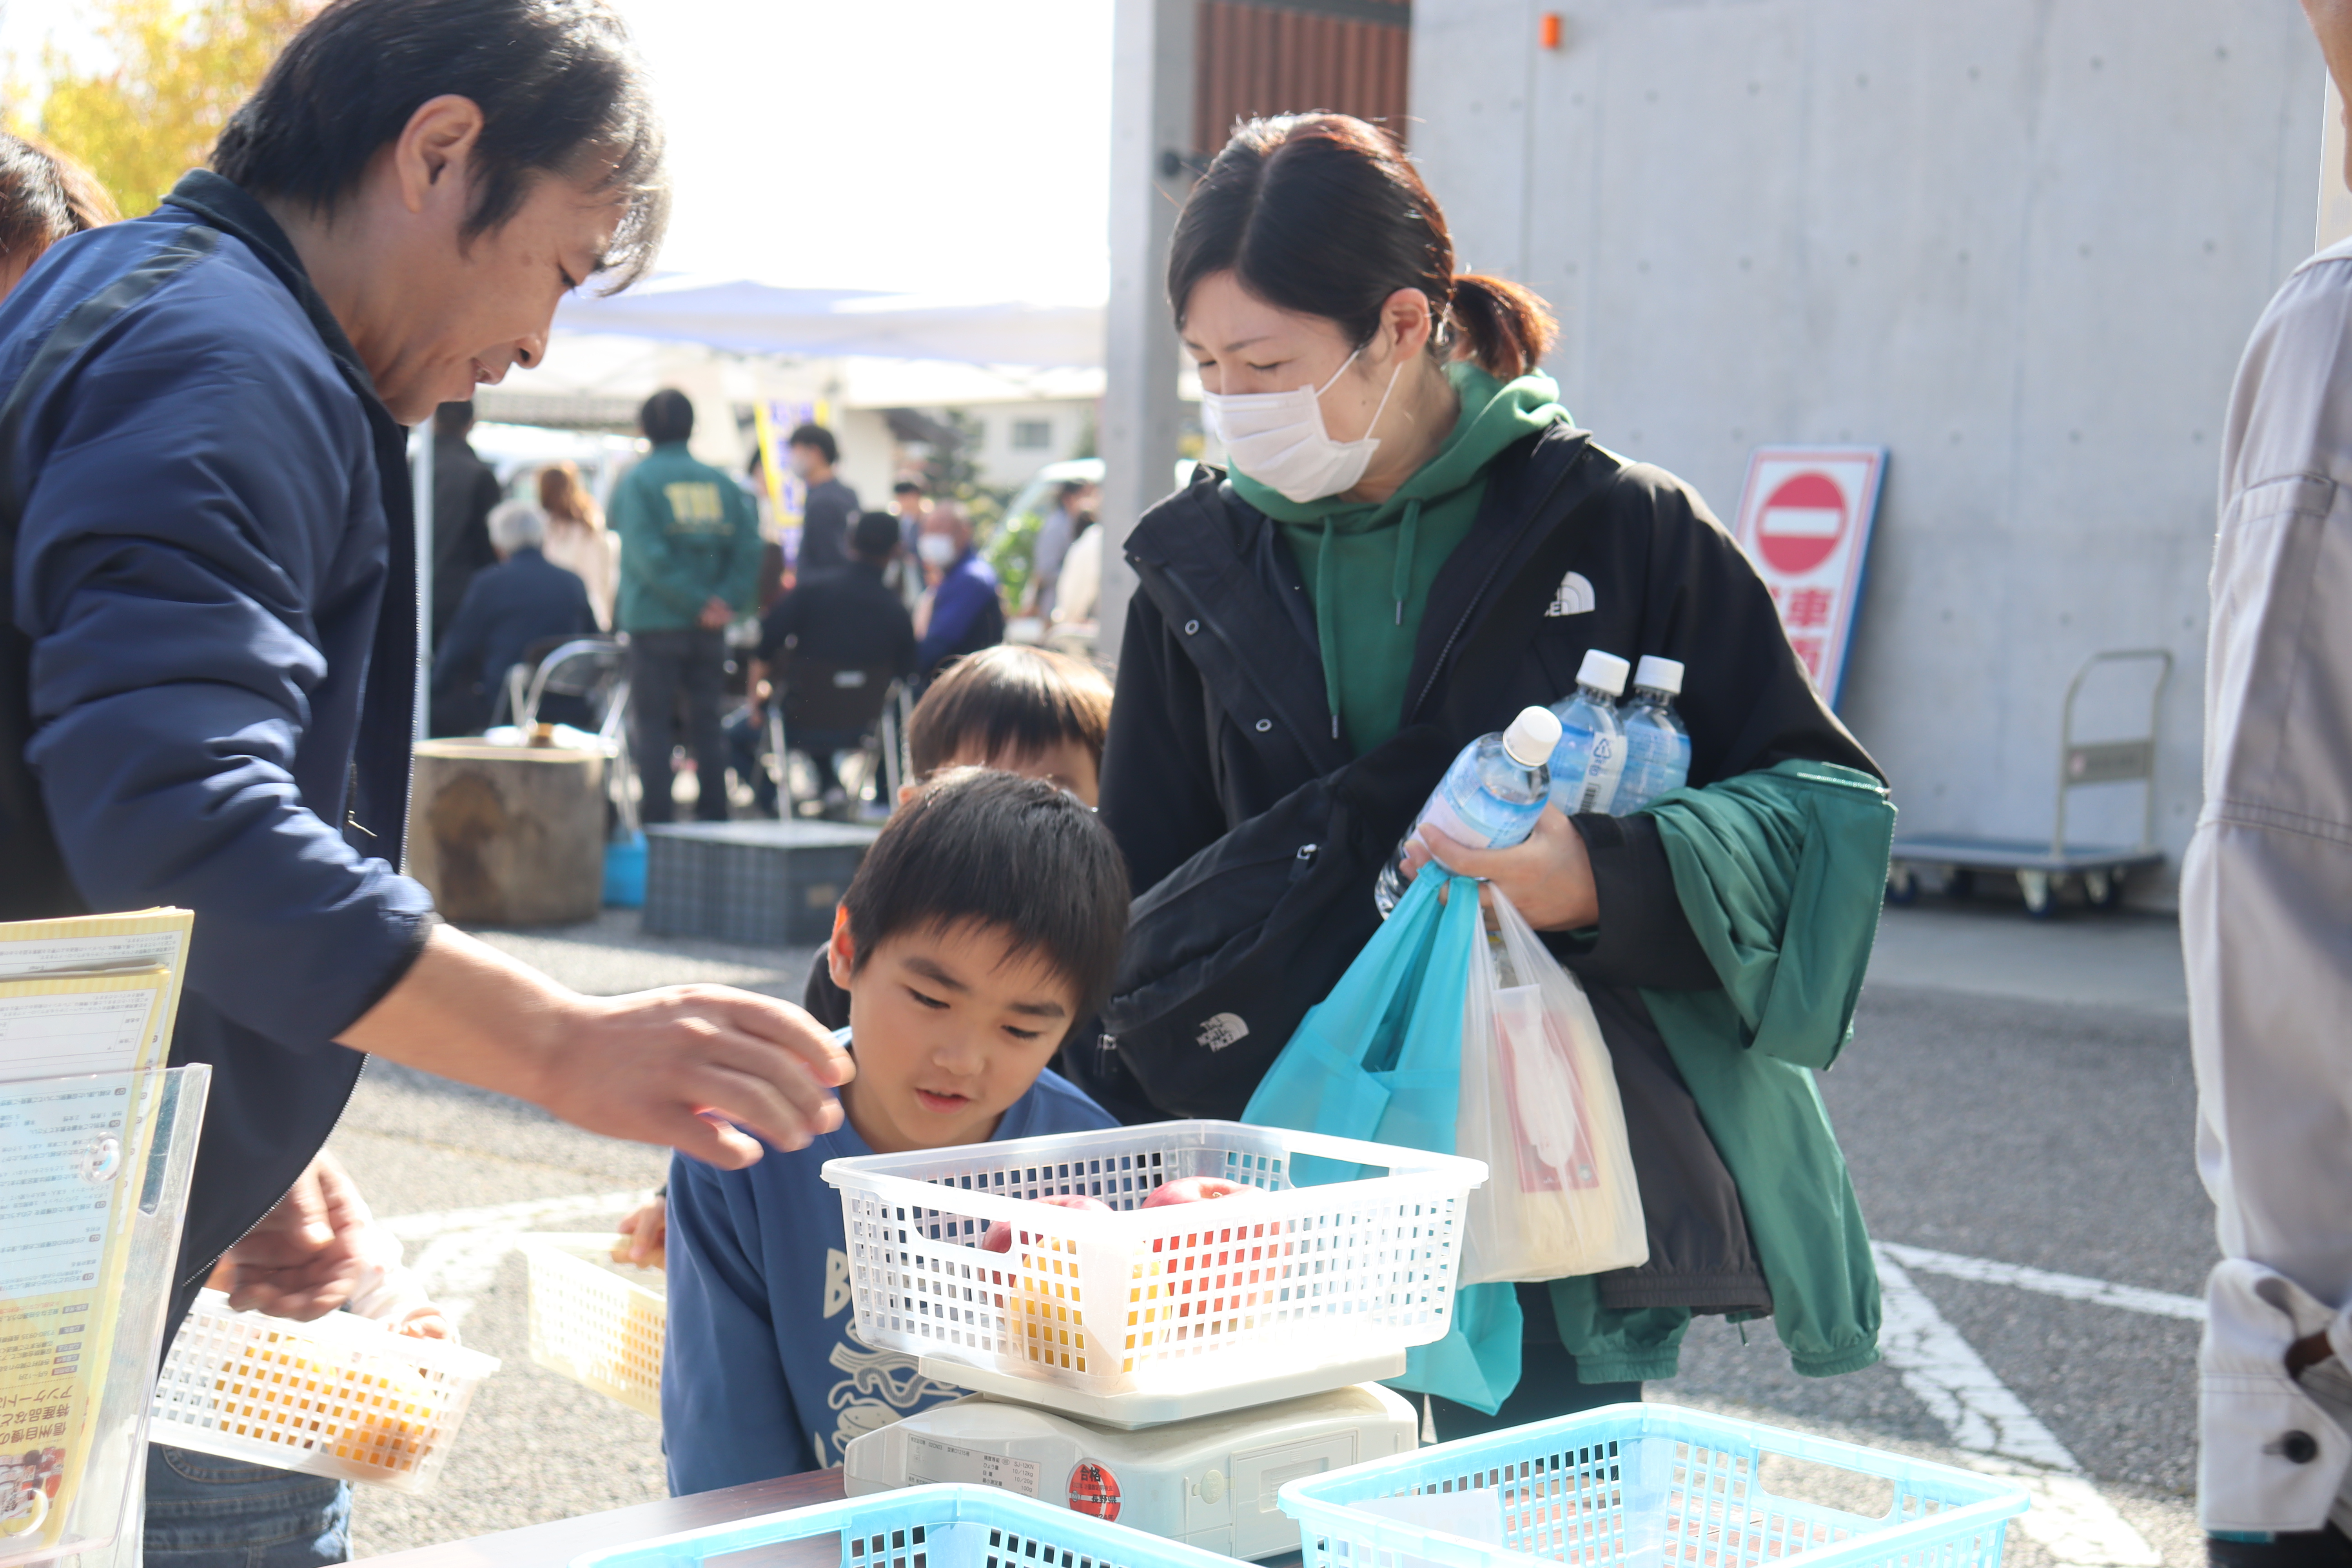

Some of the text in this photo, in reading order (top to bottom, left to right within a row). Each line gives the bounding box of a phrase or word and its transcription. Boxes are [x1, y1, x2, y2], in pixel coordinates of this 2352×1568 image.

[1013, 1468, 1033, 1477] 10/12kg
[1080, 1466, 1101, 1482] 合格
[1014, 1477, 1033, 1485] 10/20g
[1091, 1494, 1117, 1504] 長野県
